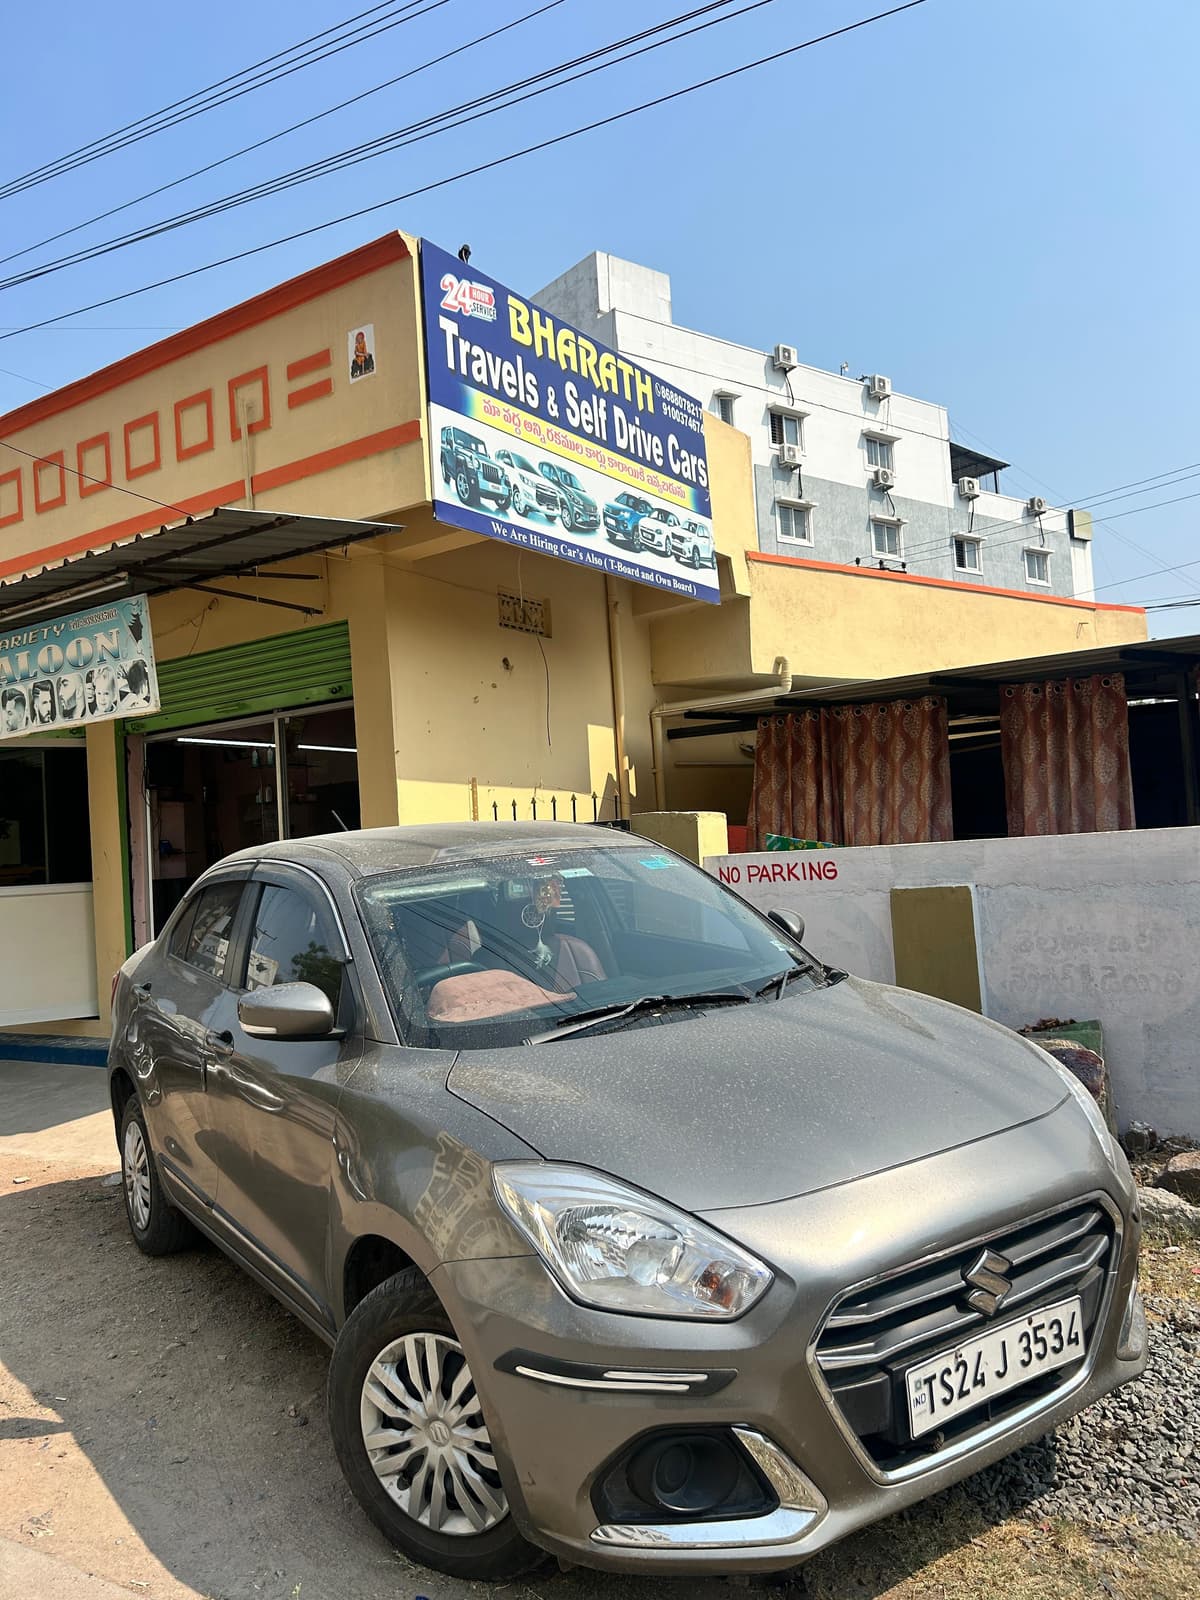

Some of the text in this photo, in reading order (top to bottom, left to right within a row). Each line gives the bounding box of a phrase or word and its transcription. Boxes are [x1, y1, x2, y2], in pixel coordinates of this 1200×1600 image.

[440, 273, 490, 316] 24 HOUR
[472, 302, 496, 319] SERVICE
[508, 295, 654, 413] BHARATH
[439, 315, 708, 487] Travels & Self Drive Cars
[491, 521, 508, 537] We
[510, 528, 527, 543] Are
[530, 533, 558, 556] Hiring
[560, 544, 583, 560] Car's
[585, 552, 603, 566] Also
[641, 570, 654, 583] and
[655, 575, 672, 588] Own
[0, 622, 65, 651] ARIETY
[0, 628, 121, 686] ALOON
[719, 861, 838, 884] NO PARKING
[923, 1311, 1080, 1415] TS24 J 3534
[912, 1392, 926, 1408] IND
